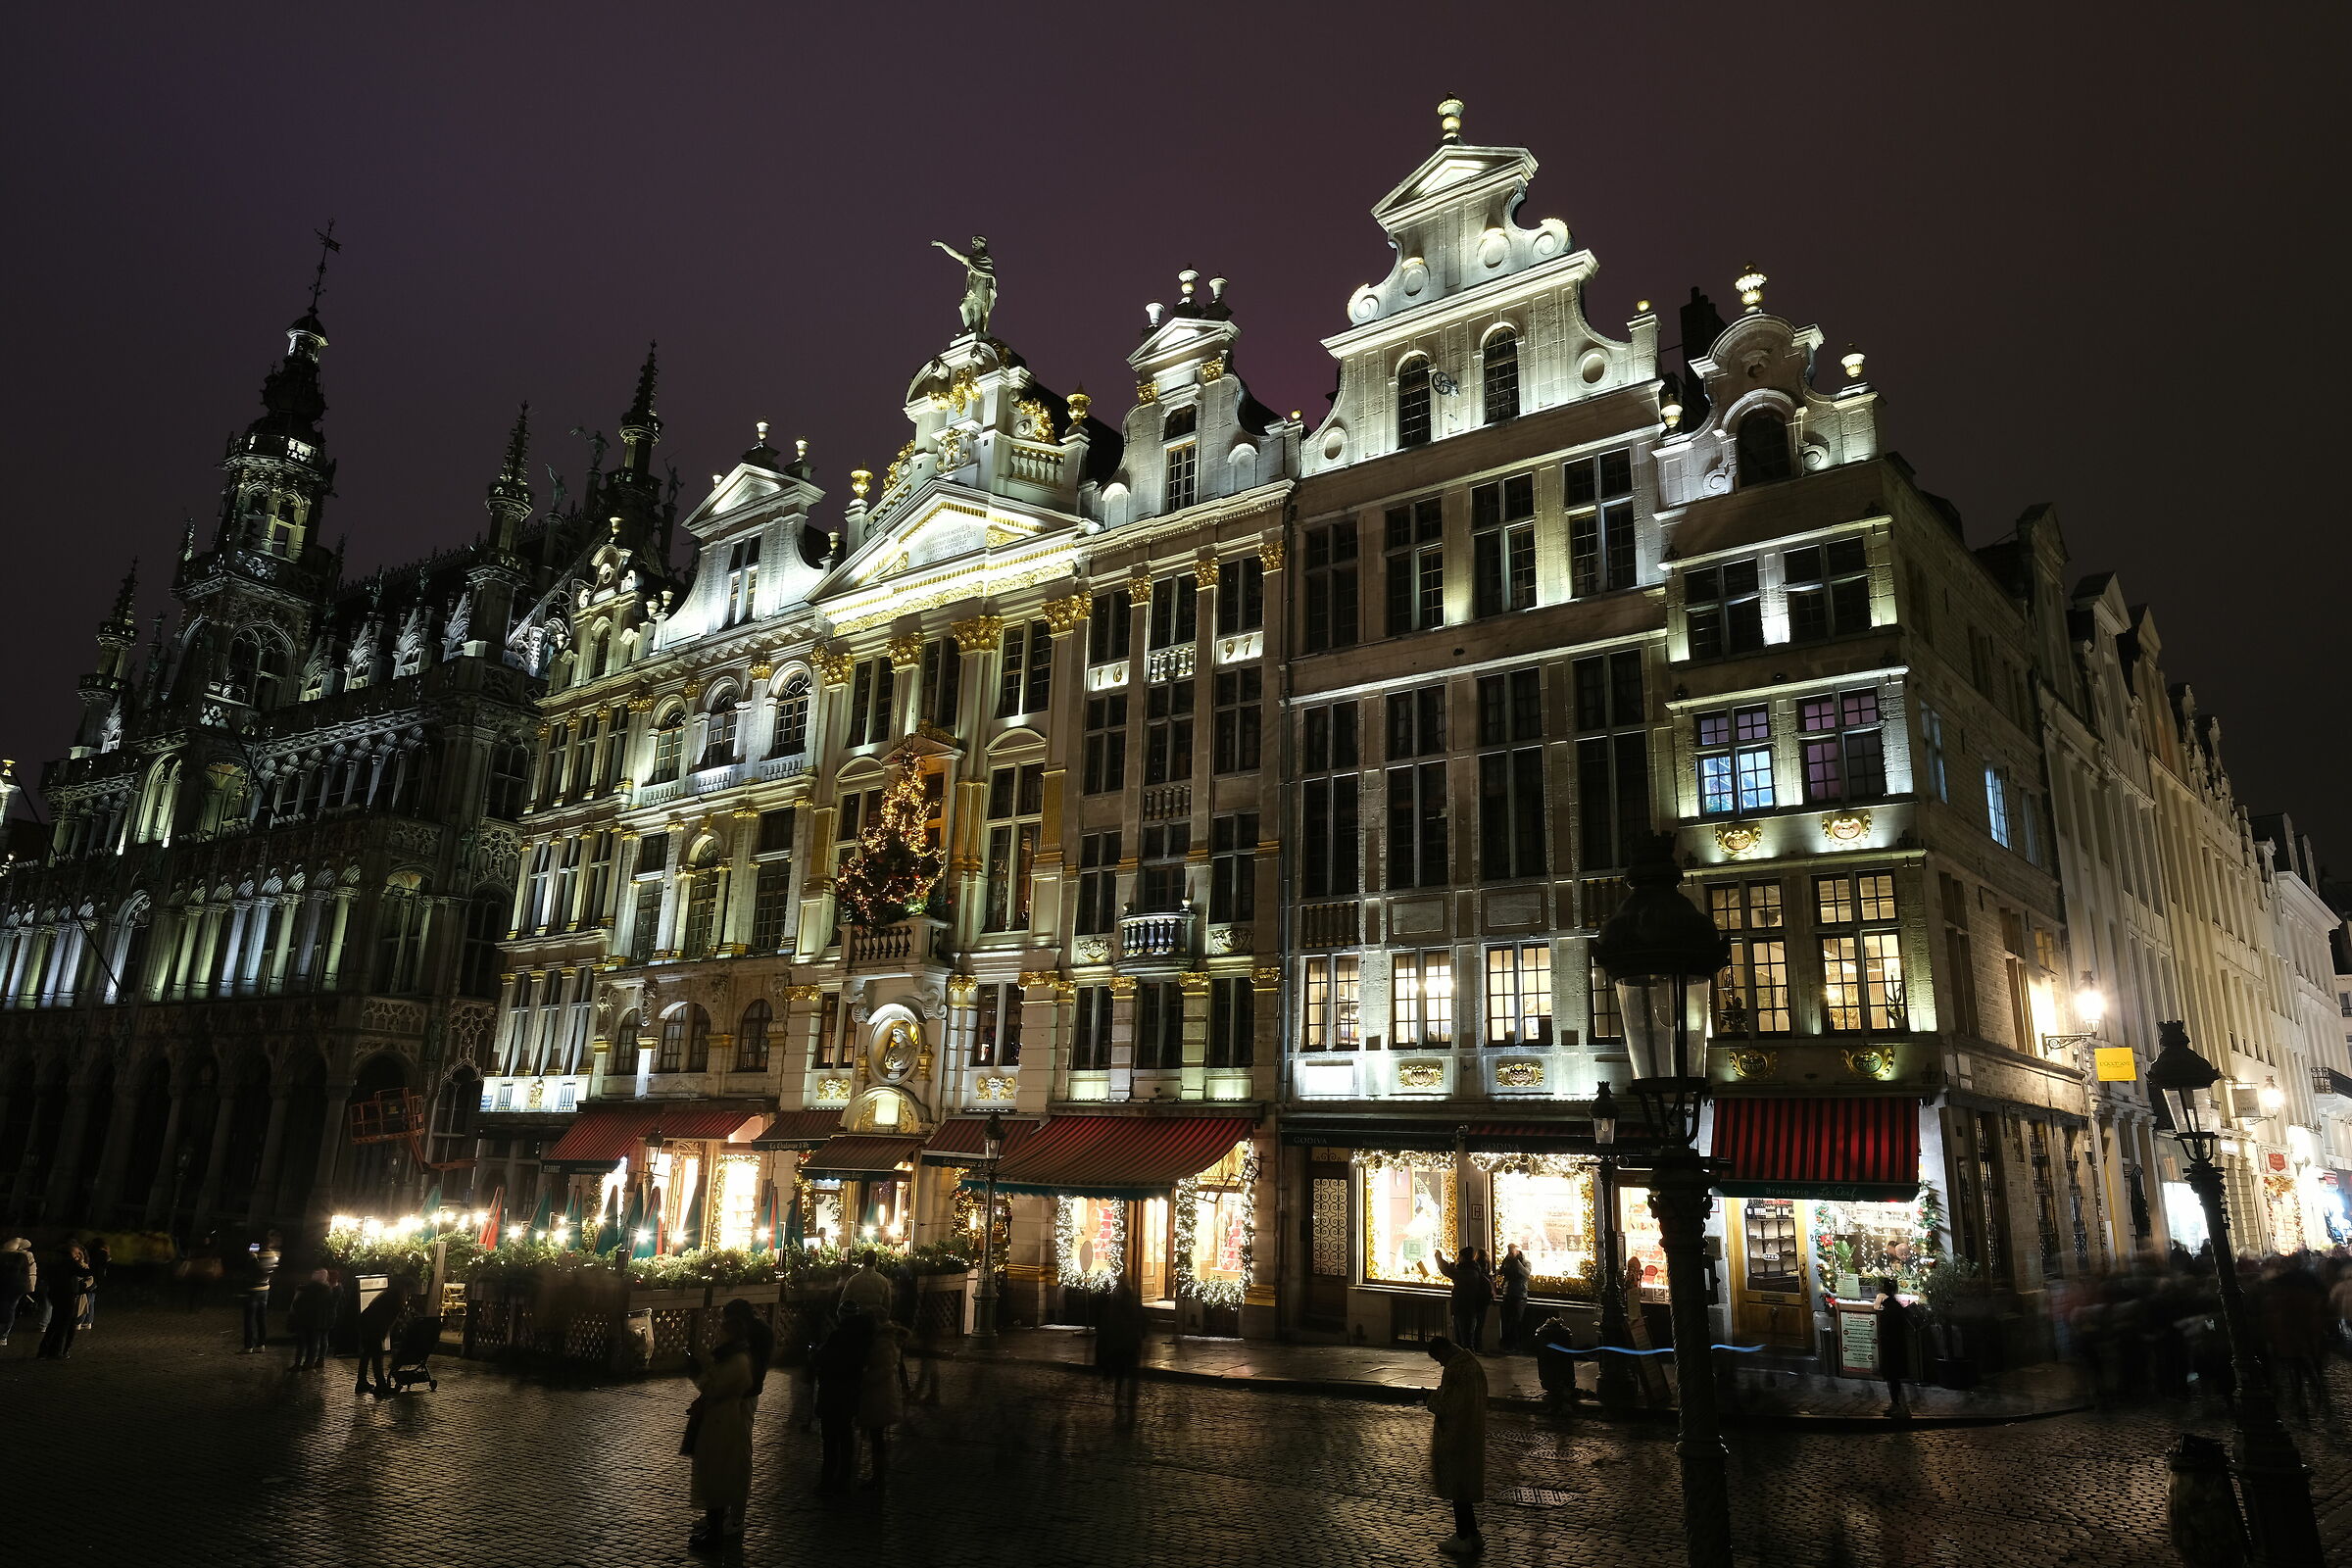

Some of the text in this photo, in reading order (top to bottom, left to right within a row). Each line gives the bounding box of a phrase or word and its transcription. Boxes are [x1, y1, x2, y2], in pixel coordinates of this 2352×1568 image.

[1293, 1136, 1328, 1145] GODIVA
[1481, 1143, 1521, 1152] GODIVA
[1766, 1187, 1809, 1197] Brasserie
[1817, 1187, 1832, 1197] Le
[1474, 1206, 1481, 1217] H
